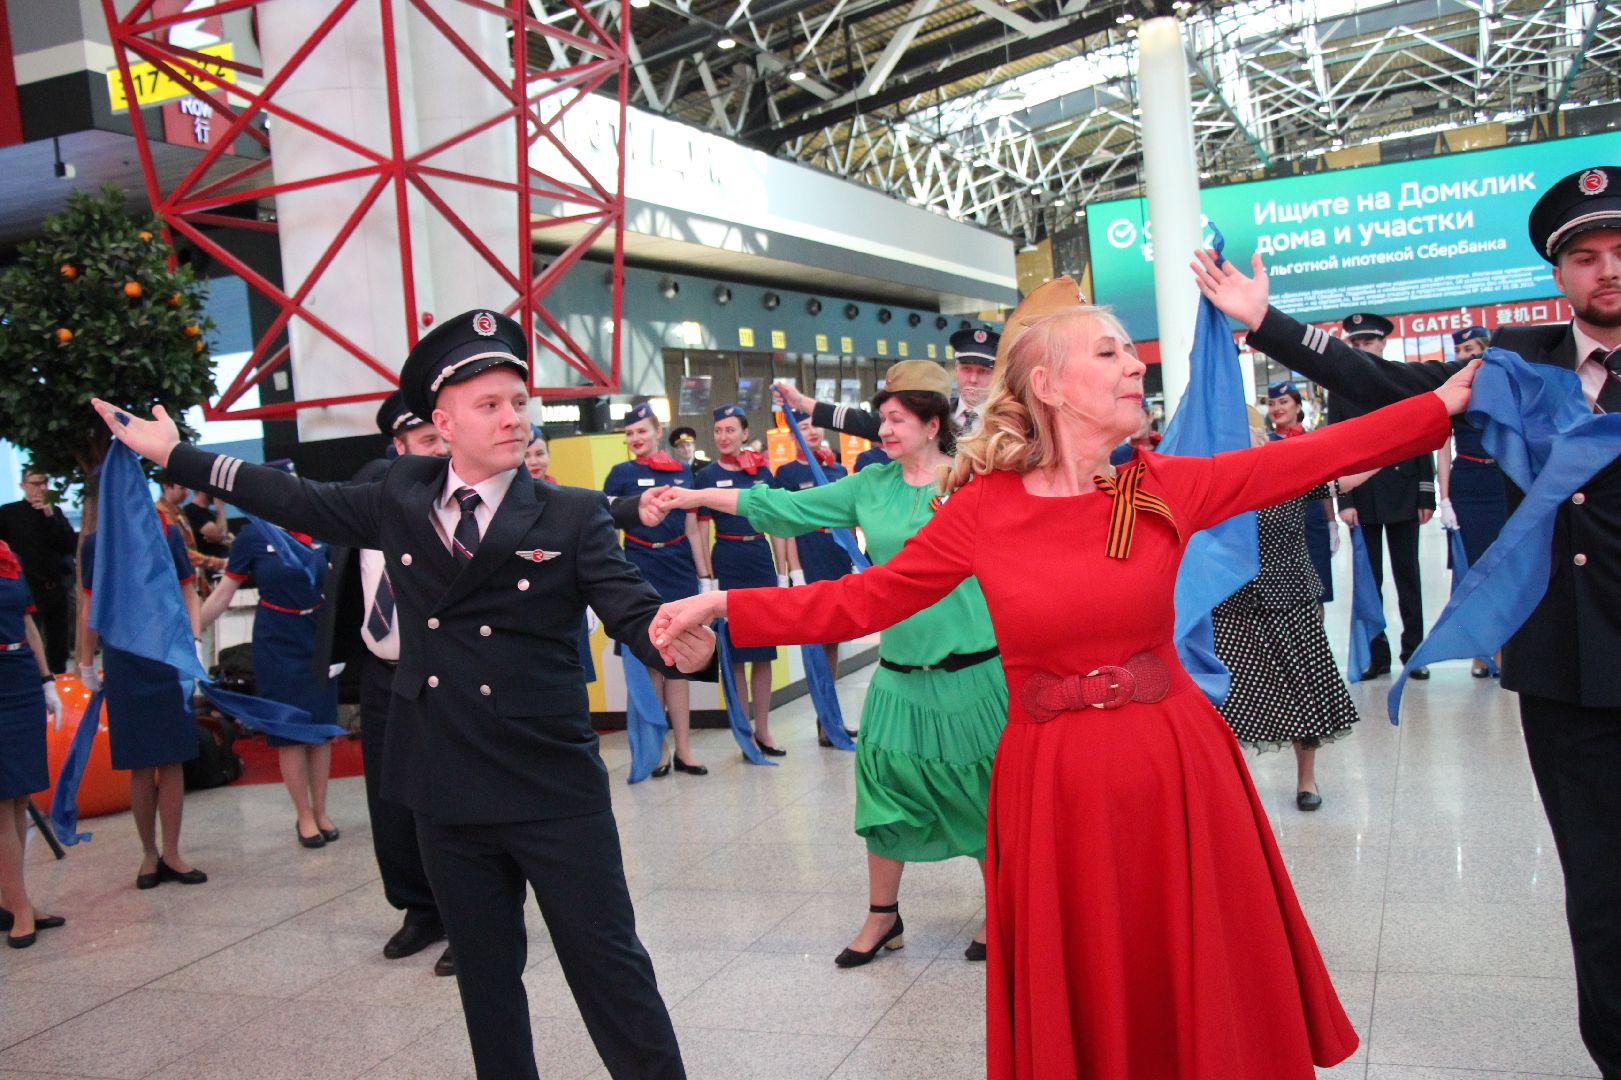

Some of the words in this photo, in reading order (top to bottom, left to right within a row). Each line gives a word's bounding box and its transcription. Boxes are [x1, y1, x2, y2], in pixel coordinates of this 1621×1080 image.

[1253, 199, 1349, 225] Ищите
[1357, 190, 1391, 212] на
[1398, 171, 1537, 211] Домклик
[1255, 228, 1326, 256] дома
[1333, 225, 1351, 245] и
[1358, 209, 1474, 247] участки
[1269, 255, 1338, 276] льготной
[1341, 245, 1414, 268] ипотекой
[1416, 238, 1507, 259] СберБанка
[1411, 312, 1473, 333] GATES
[1496, 304, 1548, 326] 登机口
